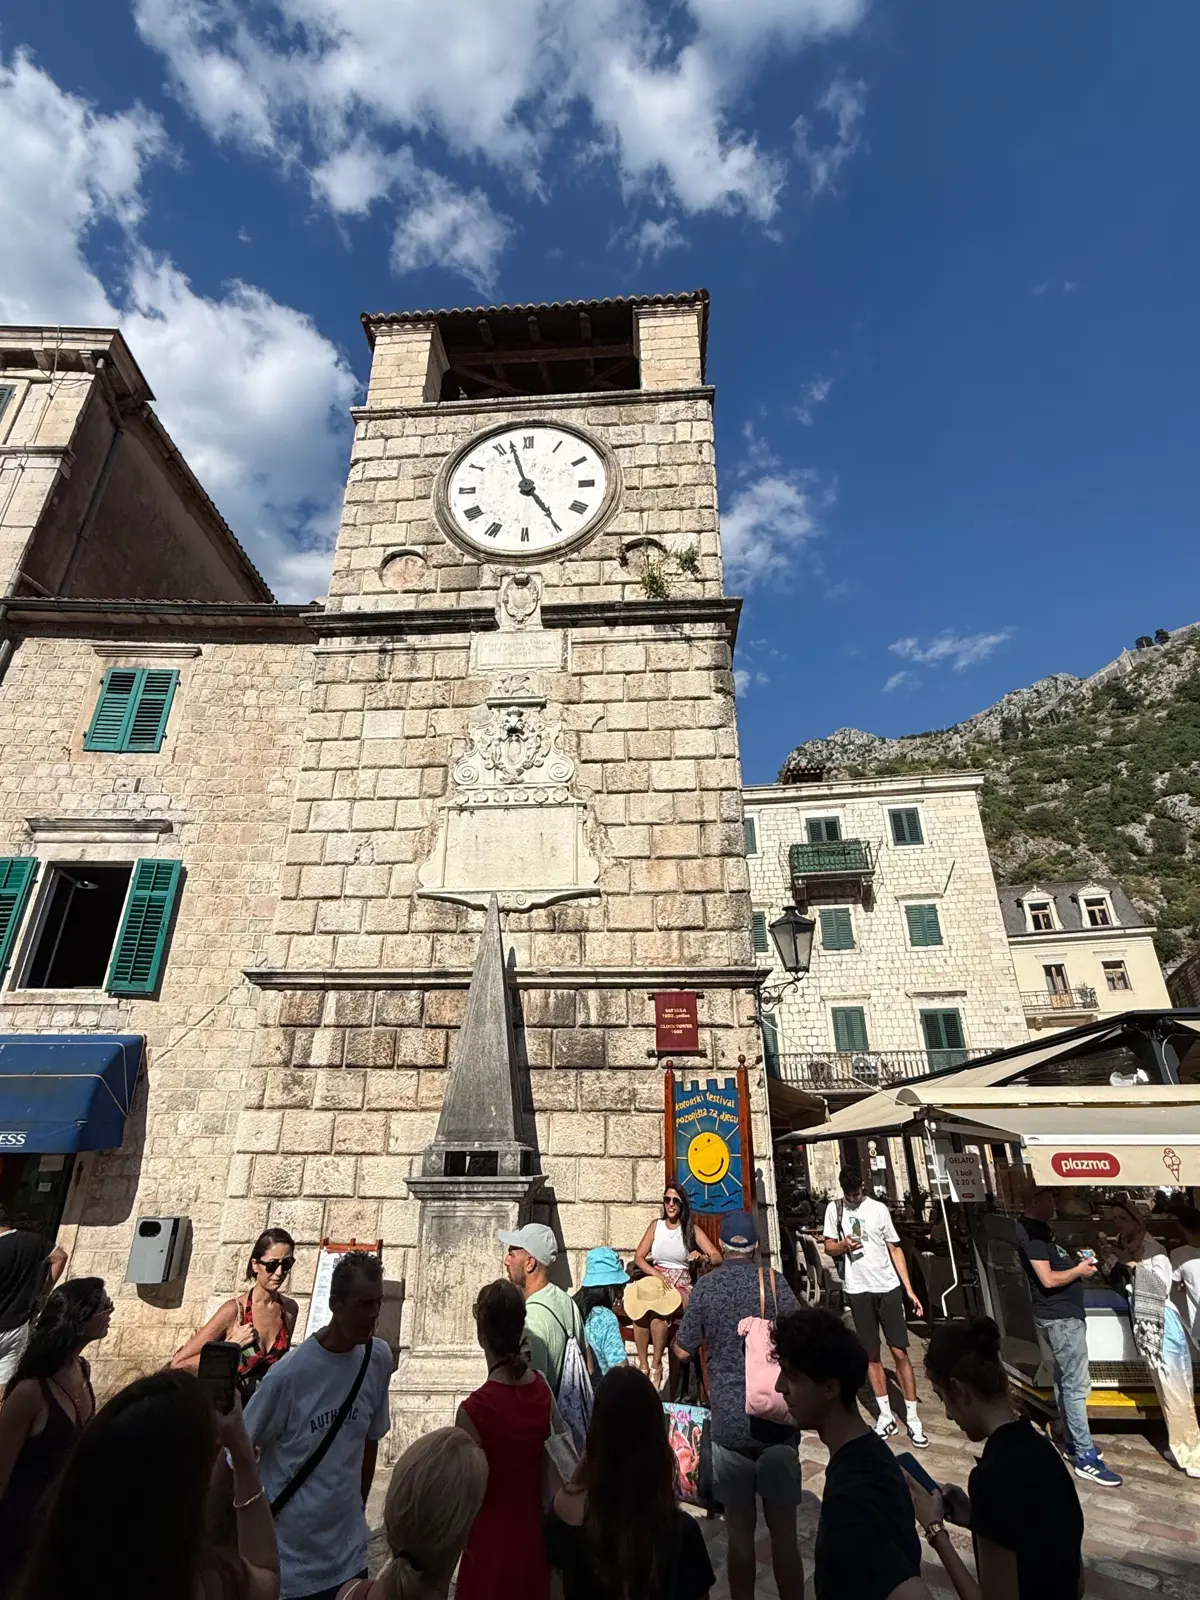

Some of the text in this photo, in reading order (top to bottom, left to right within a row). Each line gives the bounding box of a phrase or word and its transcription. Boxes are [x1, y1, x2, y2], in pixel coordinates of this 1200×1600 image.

[492, 443, 507, 457] XI
[523, 435, 535, 450] XII
[468, 463, 485, 472] X
[706, 1091, 735, 1108] festival
[709, 1108, 719, 1118] za
[720, 1111, 739, 1124] djecu
[1060, 1157, 1111, 1173] plazma
